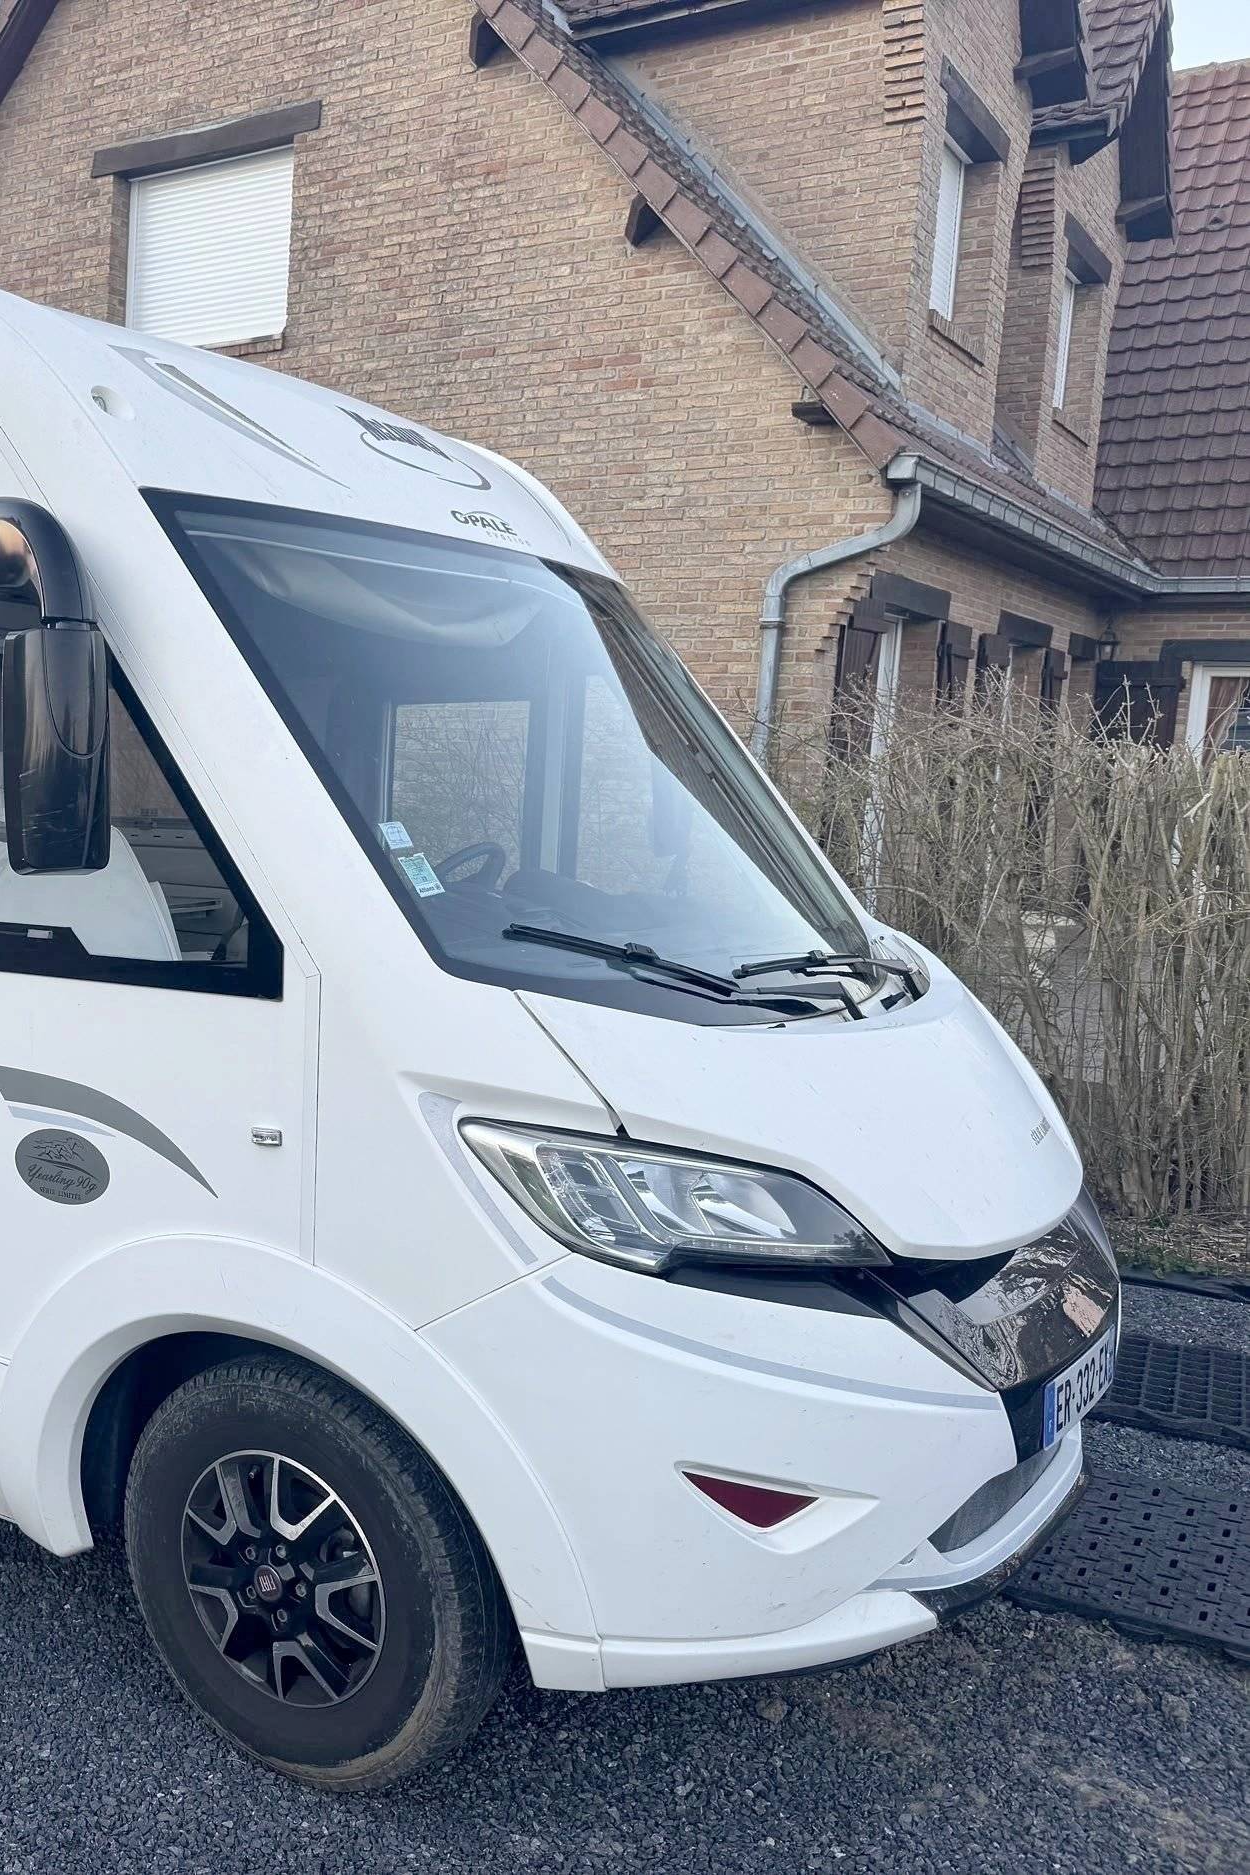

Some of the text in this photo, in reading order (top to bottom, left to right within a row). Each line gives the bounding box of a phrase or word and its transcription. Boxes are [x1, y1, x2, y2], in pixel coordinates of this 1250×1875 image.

[450, 510, 518, 536] OPALE
[28, 1163, 75, 1190] Yearling
[258, 1573, 277, 1592] FIAT
